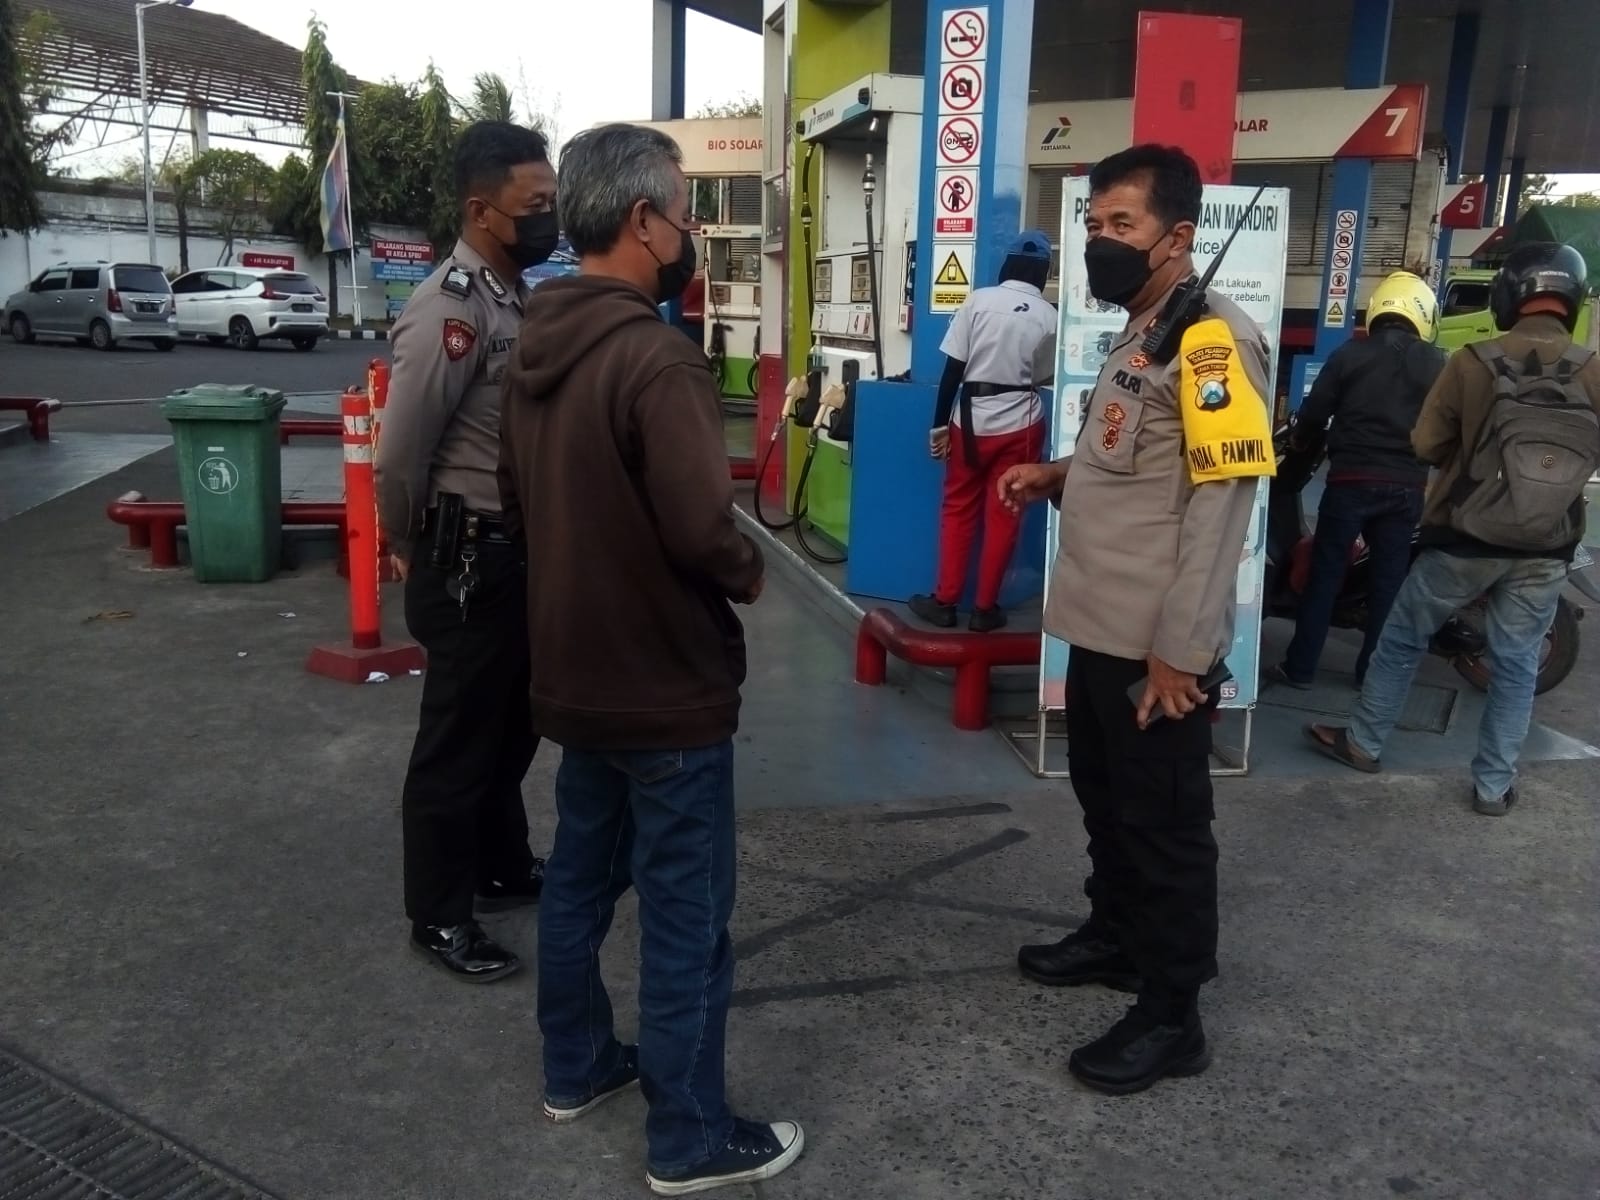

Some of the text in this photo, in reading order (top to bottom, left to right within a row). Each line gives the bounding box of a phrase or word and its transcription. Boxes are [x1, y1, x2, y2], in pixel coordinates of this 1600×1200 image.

[1233, 119, 1268, 132] LAR
[1385, 108, 1408, 137] 7
[708, 140, 726, 150] BIO
[1459, 195, 1475, 214] 5
[1224, 203, 1279, 231] MANDIRI
[376, 241, 404, 250] DILARANG
[1226, 278, 1262, 288] Lakukan
[1234, 292, 1271, 302] sebelum
[1069, 344, 1079, 358] 2
[1111, 369, 1142, 395] POLRI
[1066, 402, 1076, 416] 3
[1221, 440, 1268, 465] PAMWIL
